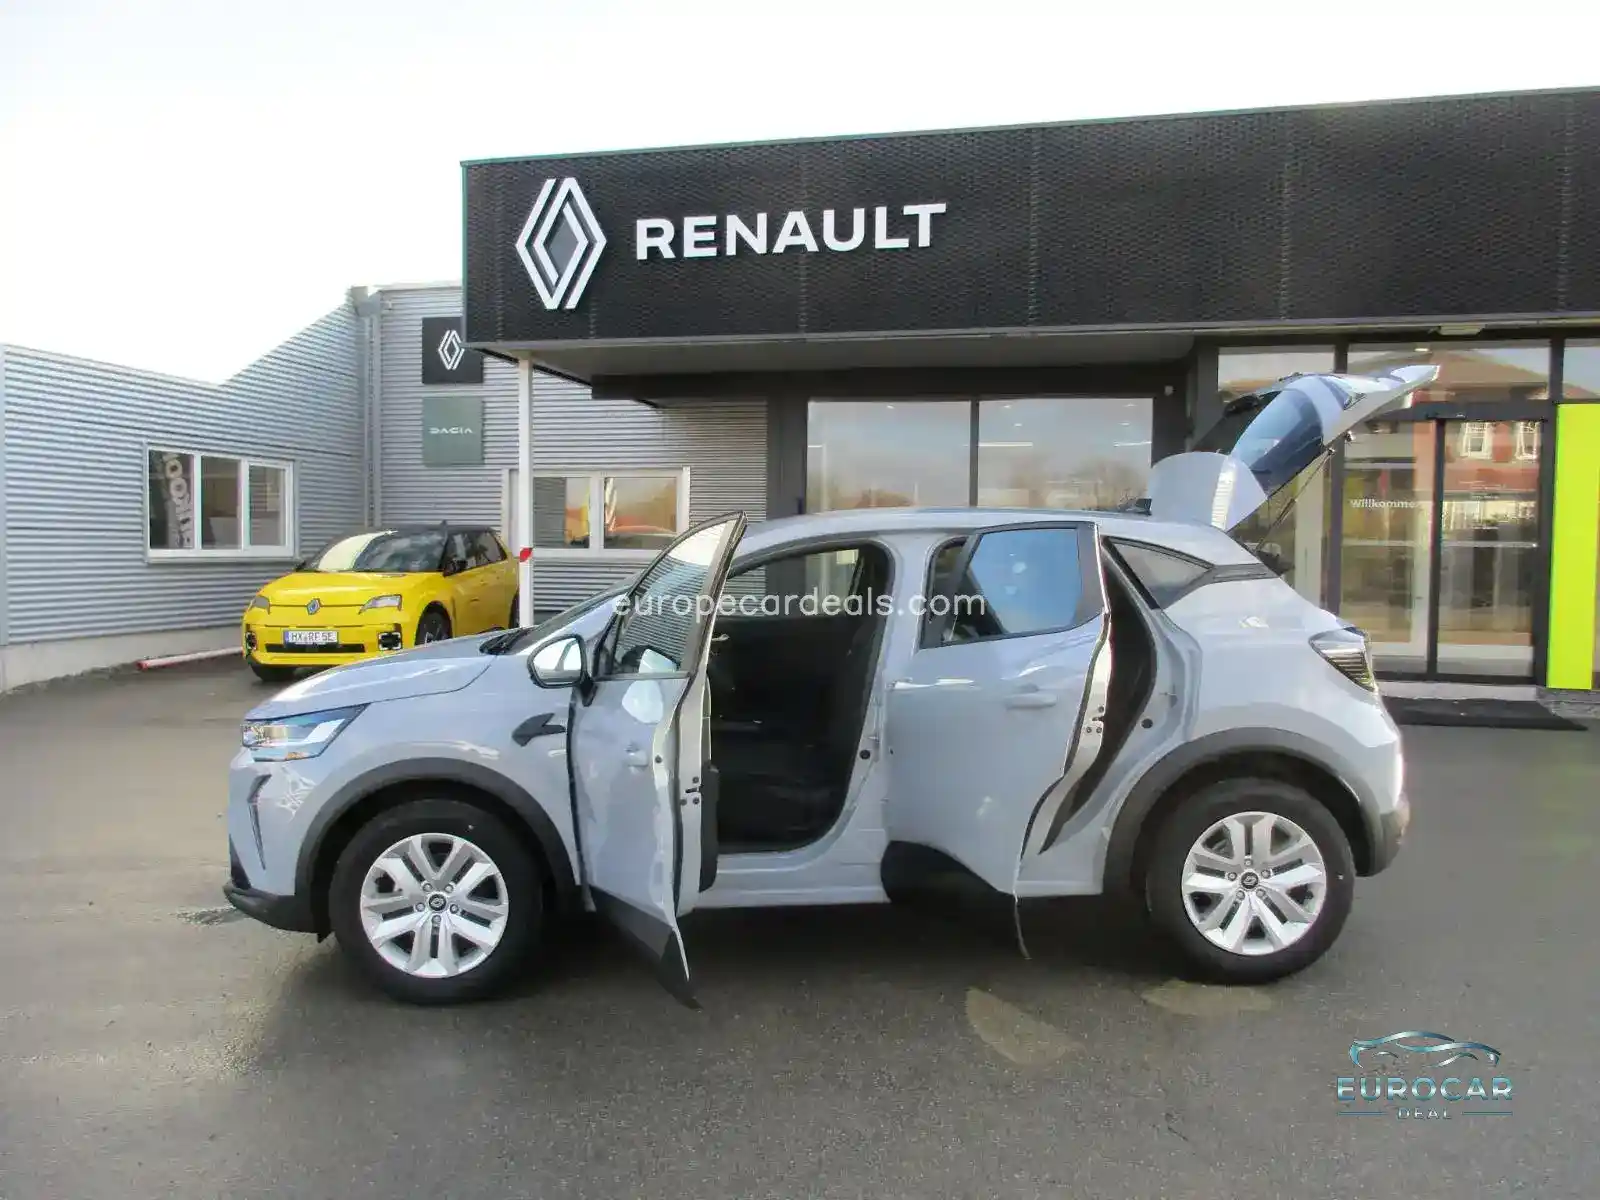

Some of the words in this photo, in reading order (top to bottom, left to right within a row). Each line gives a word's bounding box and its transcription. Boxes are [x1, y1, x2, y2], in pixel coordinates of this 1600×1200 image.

[636, 203, 947, 261] RENAULT
[429, 426, 473, 435] DACIA
[1350, 498, 1421, 510] Willkomme
